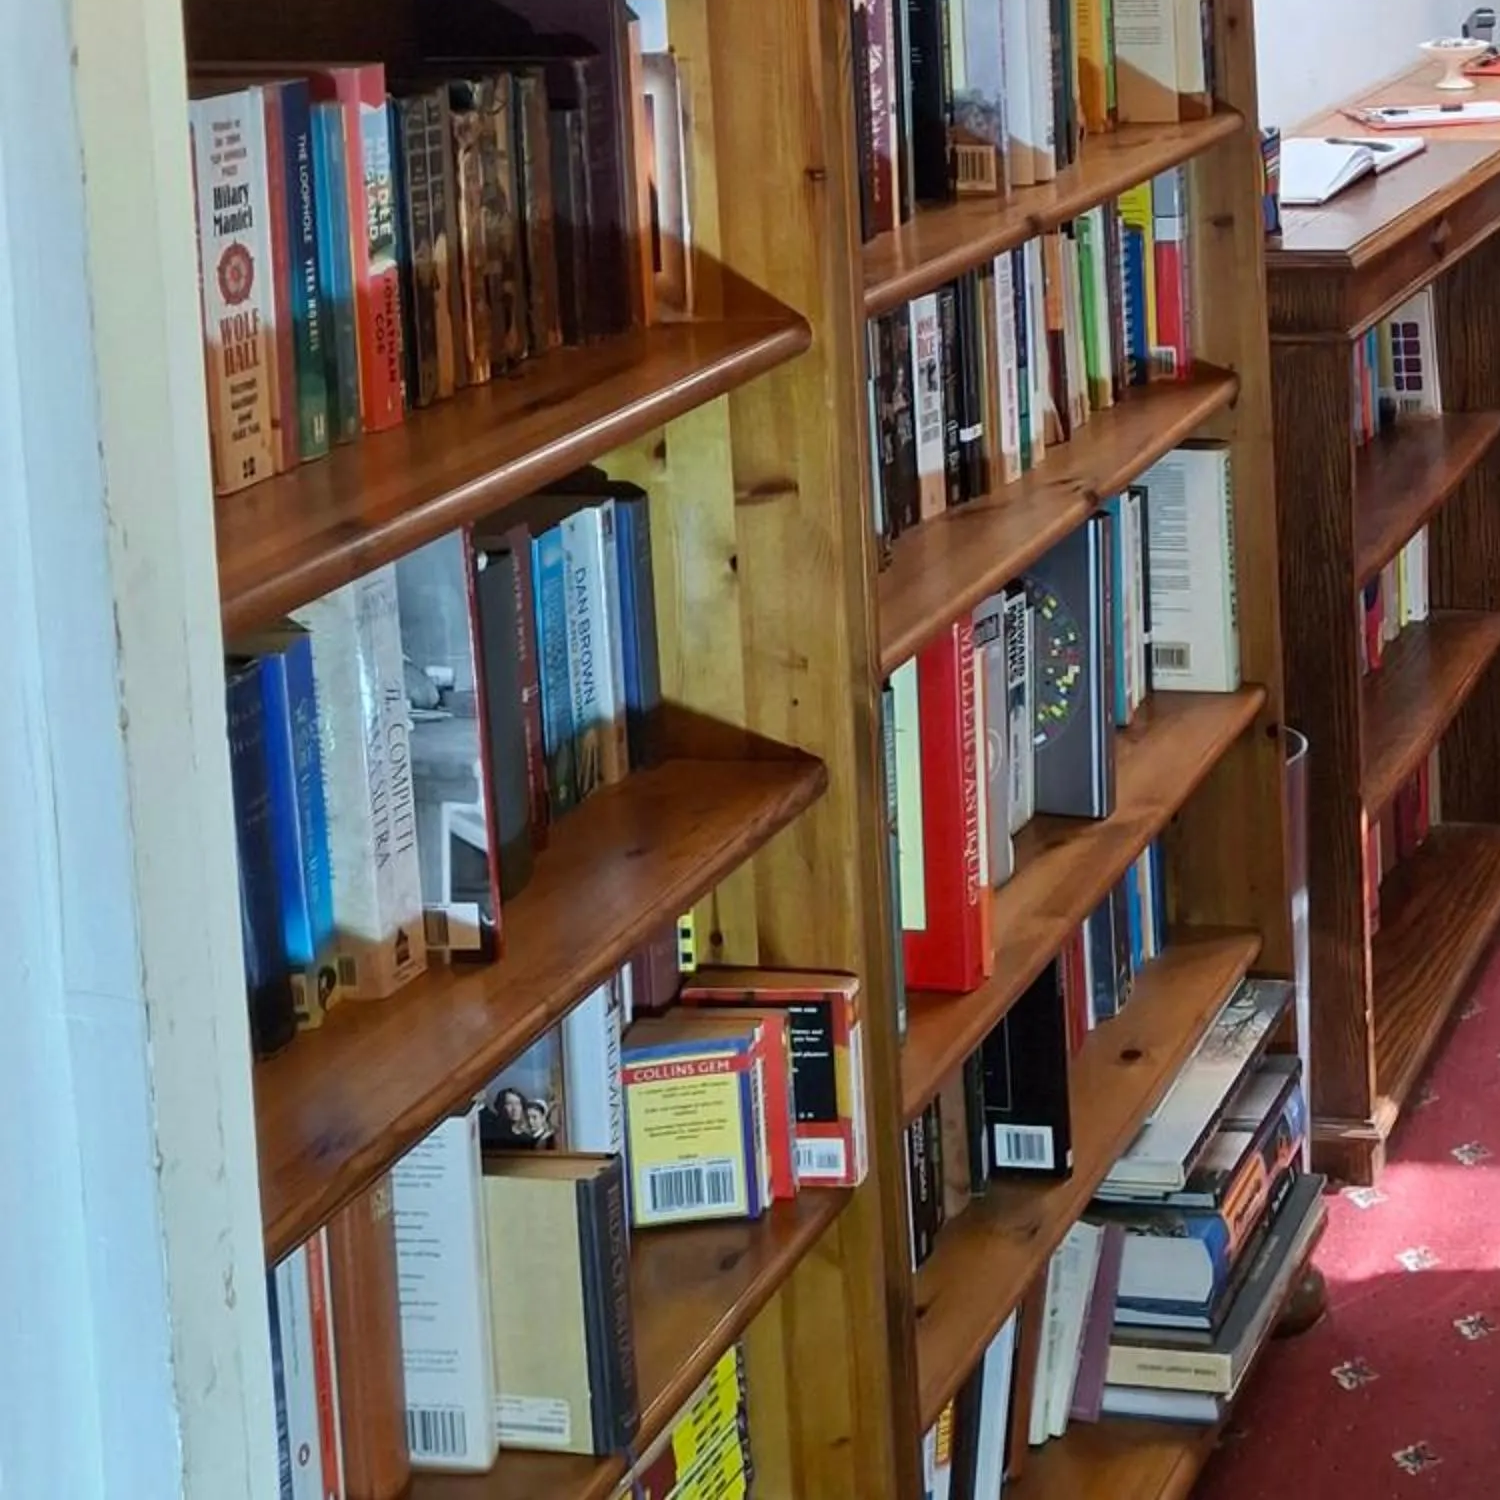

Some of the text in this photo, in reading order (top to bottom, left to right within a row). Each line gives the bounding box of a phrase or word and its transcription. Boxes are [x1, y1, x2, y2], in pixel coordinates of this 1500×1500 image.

[298, 132, 309, 163] THE
[213, 183, 249, 211] Hilary
[299, 165, 313, 244] LOOPHOLE
[213, 204, 253, 238] Mantel
[220, 307, 260, 347] WOLF
[224, 339, 260, 378] HALL
[573, 566, 597, 706] DAN BROWN
[369, 785, 392, 870] SUTRA
[963, 777, 982, 907] ANTIQUES
[634, 1059, 729, 1081] COLLINS GEM
[607, 1181, 623, 1256] BIRDS
